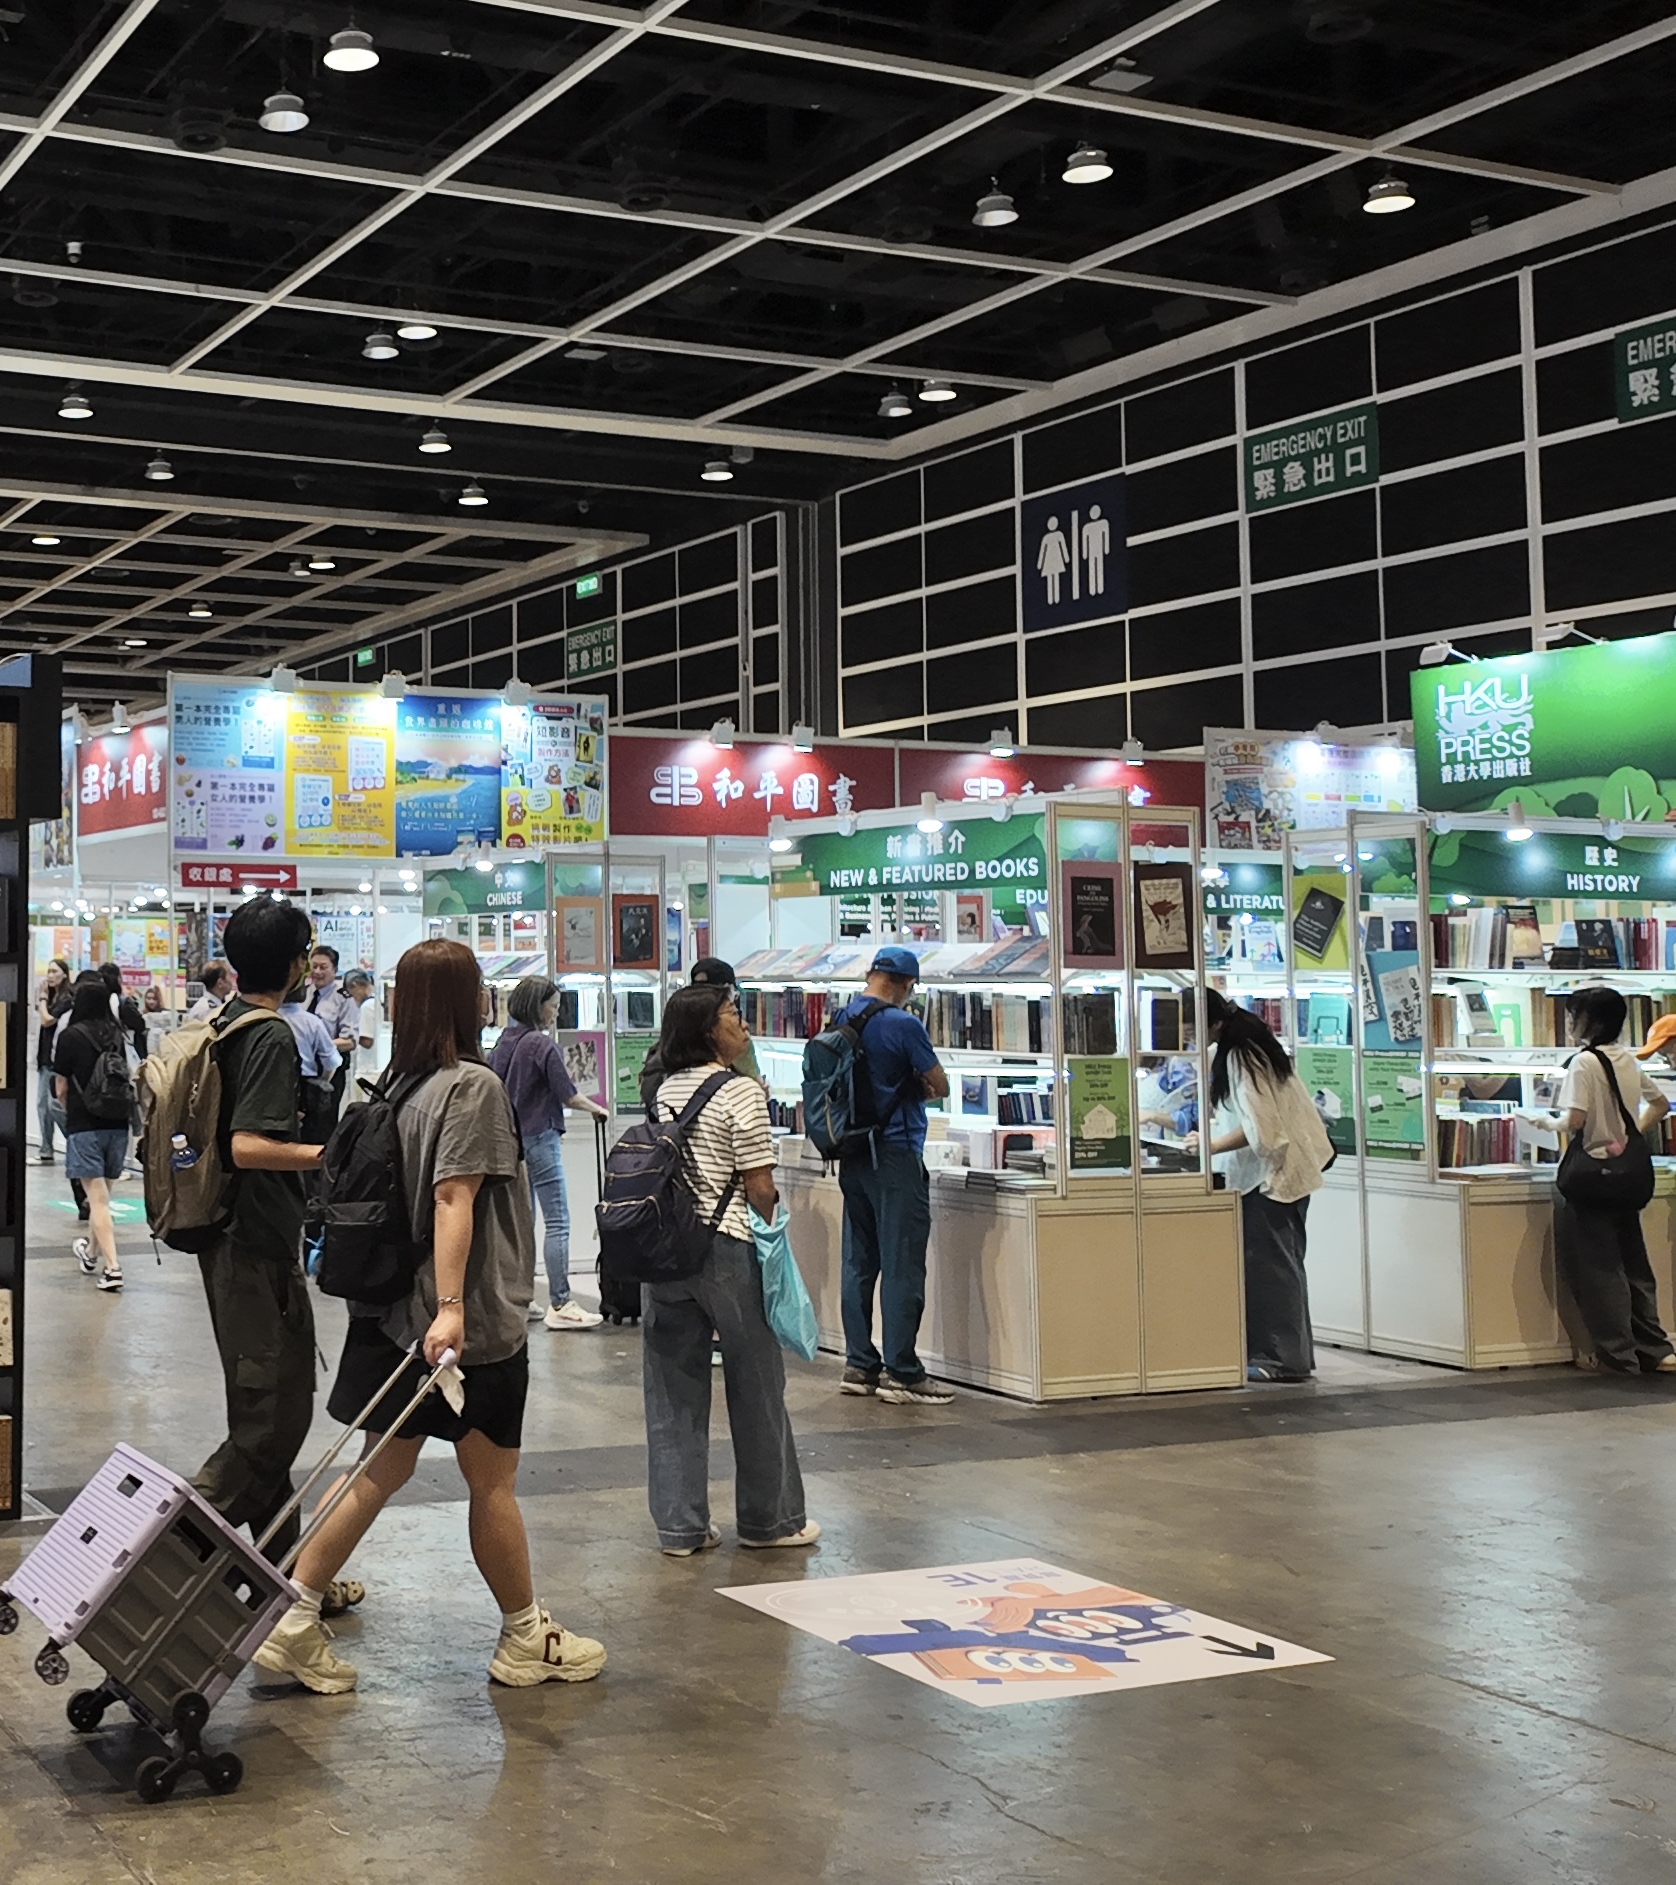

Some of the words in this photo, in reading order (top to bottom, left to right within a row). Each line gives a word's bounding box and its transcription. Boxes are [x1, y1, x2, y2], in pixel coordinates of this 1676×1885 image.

[1253, 424, 1332, 466] EMERGENCY
[1337, 415, 1367, 444] EXIT
[1253, 446, 1367, 500] 緊急出口
[568, 629, 601, 651] EMERGENCY
[602, 625, 615, 642] EXIT
[568, 644, 615, 673] 緊急出口
[1437, 673, 1529, 717] HKU
[536, 725, 570, 738] 短影音
[1440, 730, 1531, 763] PRESS
[102, 750, 163, 800] 和平圖書
[1441, 757, 1532, 783] 香港大學出版社
[712, 767, 857, 816] 和平圖書
[887, 829, 966, 858] 新書推介
[1584, 846, 1619, 867] 歷史
[495, 870, 514, 888] 中文
[830, 869, 864, 888] NEW
[868, 867, 878, 885] &
[882, 862, 969, 884] FEATURED
[975, 857, 1039, 879] BOOKS
[1566, 873, 1641, 894] HISTORY
[487, 891, 522, 906] CHINESE
[1206, 894, 1217, 908] &
[324, 920, 338, 932] AI
[926, 1572, 997, 1588] 1E
[543, 1631, 562, 1665] C
